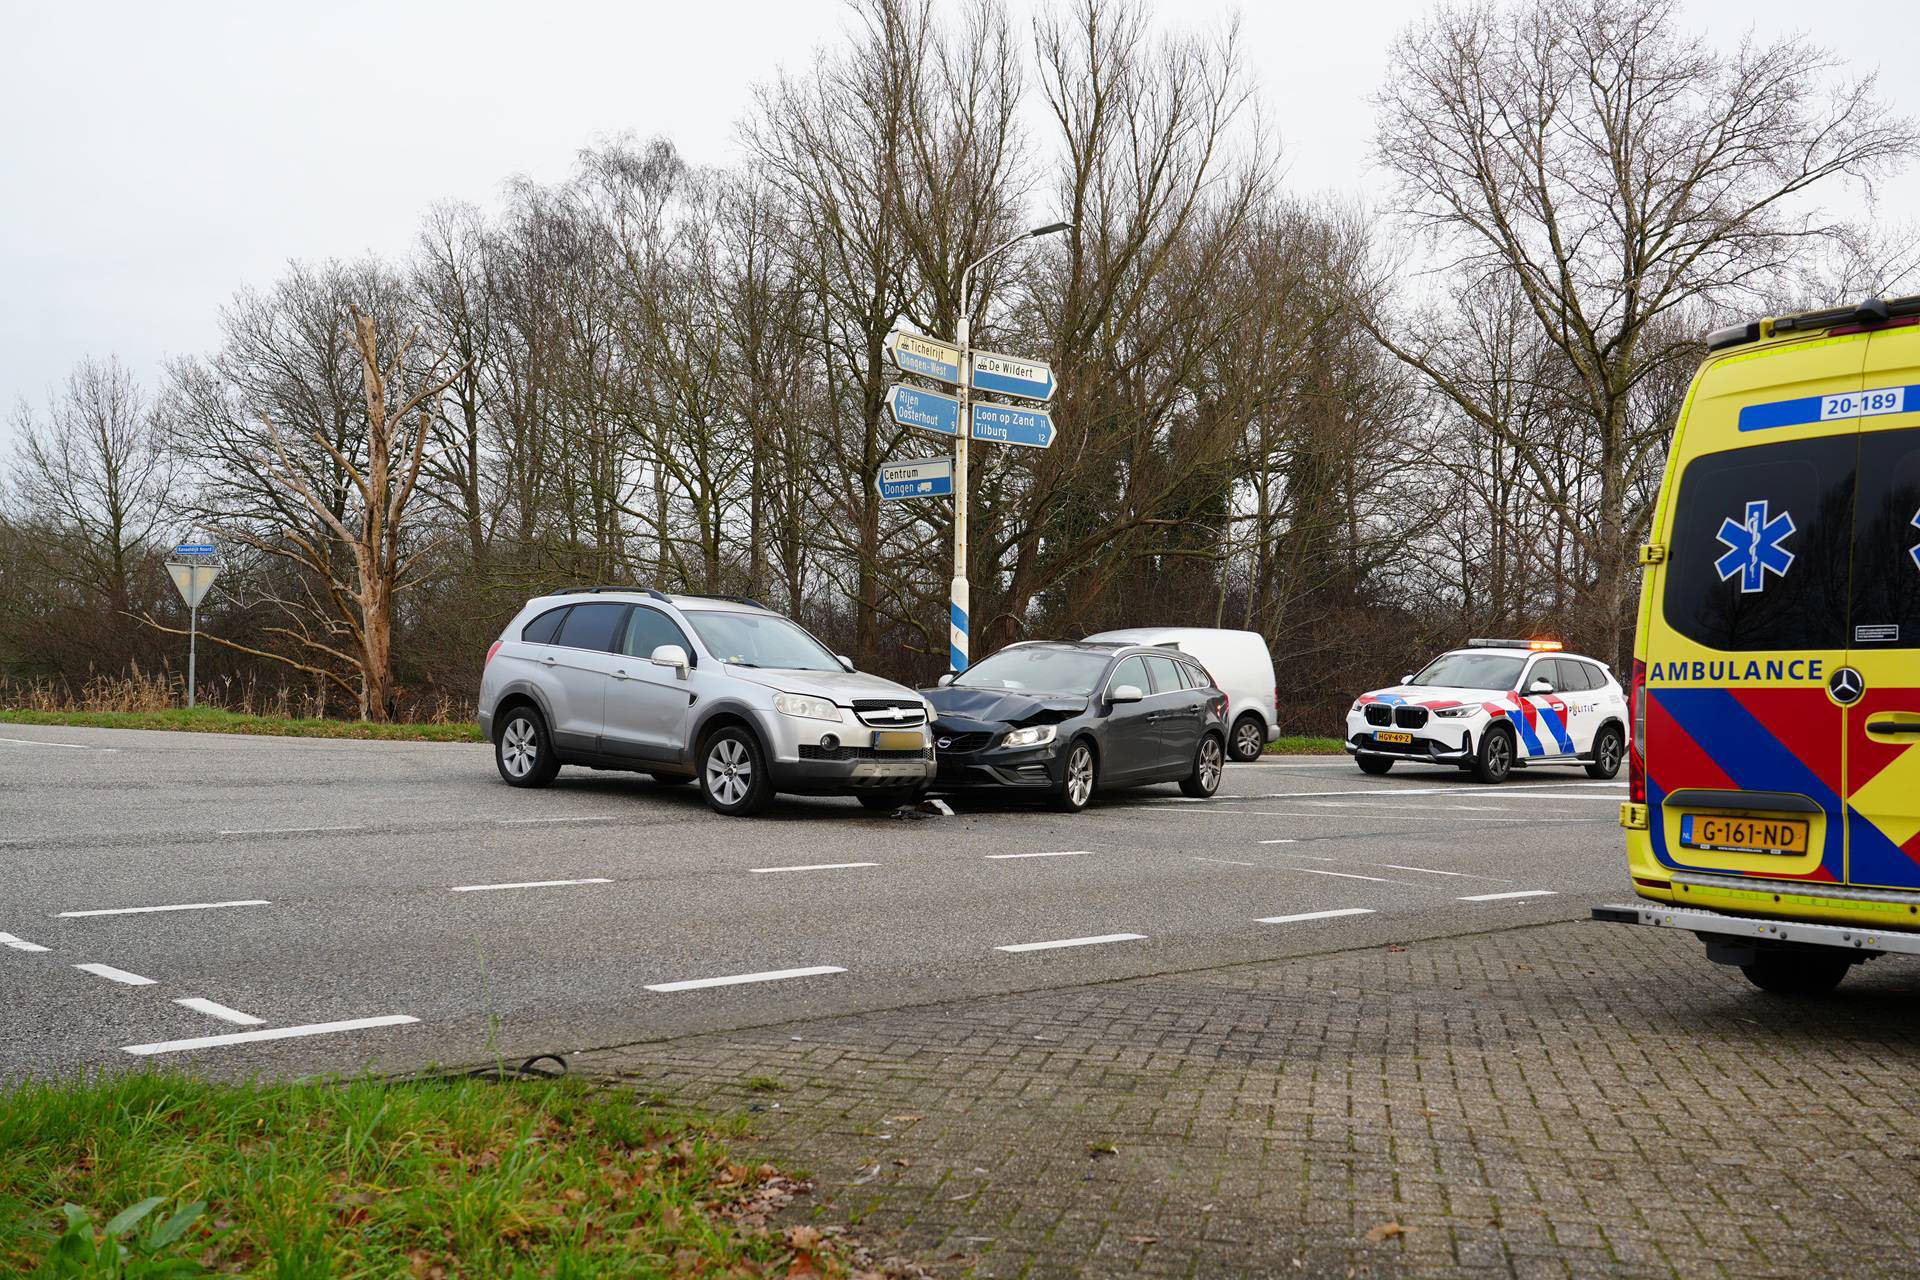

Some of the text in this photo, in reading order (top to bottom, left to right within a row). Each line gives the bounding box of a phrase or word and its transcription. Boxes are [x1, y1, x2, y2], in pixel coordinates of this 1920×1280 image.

[911, 340, 944, 361] Tichelrijt
[901, 353, 946, 376] Dongen-West
[989, 361, 1033, 378] De Wildert
[900, 391, 919, 408] Rijen
[1828, 393, 1897, 415] 20-189
[899, 406, 938, 426] Oosterhout
[952, 406, 957, 415] 7
[976, 409, 1035, 426] Loon op Zand
[950, 421, 955, 430] 9
[976, 423, 1007, 440] Tilburg
[1040, 420, 1046, 429] 11
[1038, 433, 1046, 442] 12
[884, 469, 919, 480] Centrum
[884, 483, 914, 496] Dongen
[1650, 660, 1823, 681] AMBULANCE
[1703, 821, 1795, 846] G-161-ND
